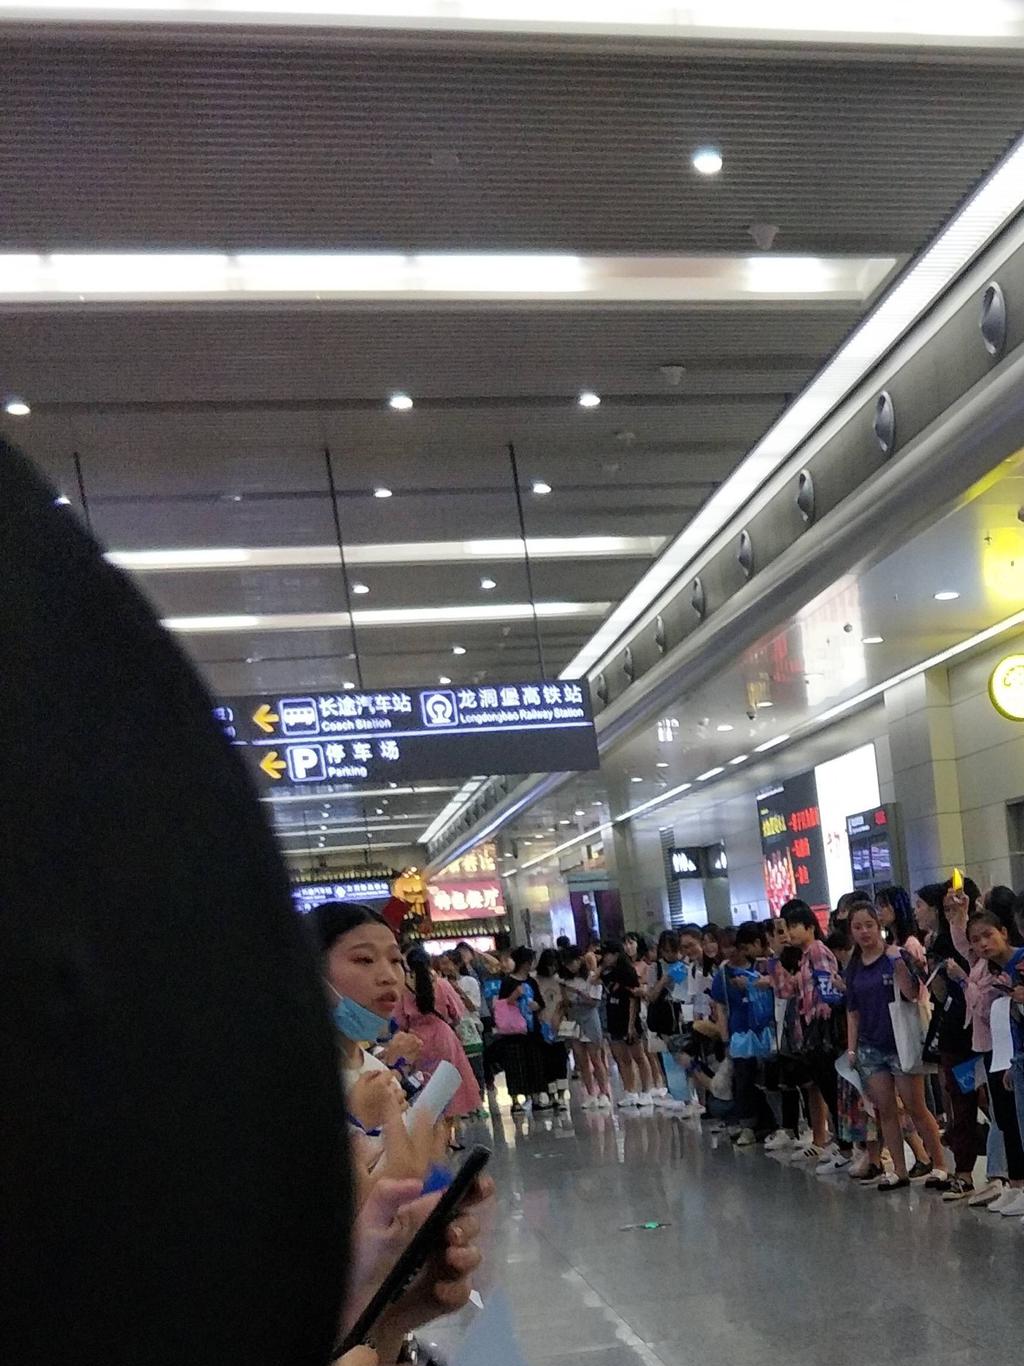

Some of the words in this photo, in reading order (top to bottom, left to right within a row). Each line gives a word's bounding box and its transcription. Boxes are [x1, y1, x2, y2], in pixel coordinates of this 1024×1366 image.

[319, 693, 412, 718] 长途汽车站
[458, 684, 584, 709] 龙洞堡高铁站
[321, 720, 354, 732] Coach
[356, 718, 392, 730] Station
[459, 711, 519, 725] Longdongbao
[520, 708, 553, 721] Railway
[554, 706, 585, 719] Station
[326, 740, 400, 763] 停车场
[328, 766, 368, 778] Parking
